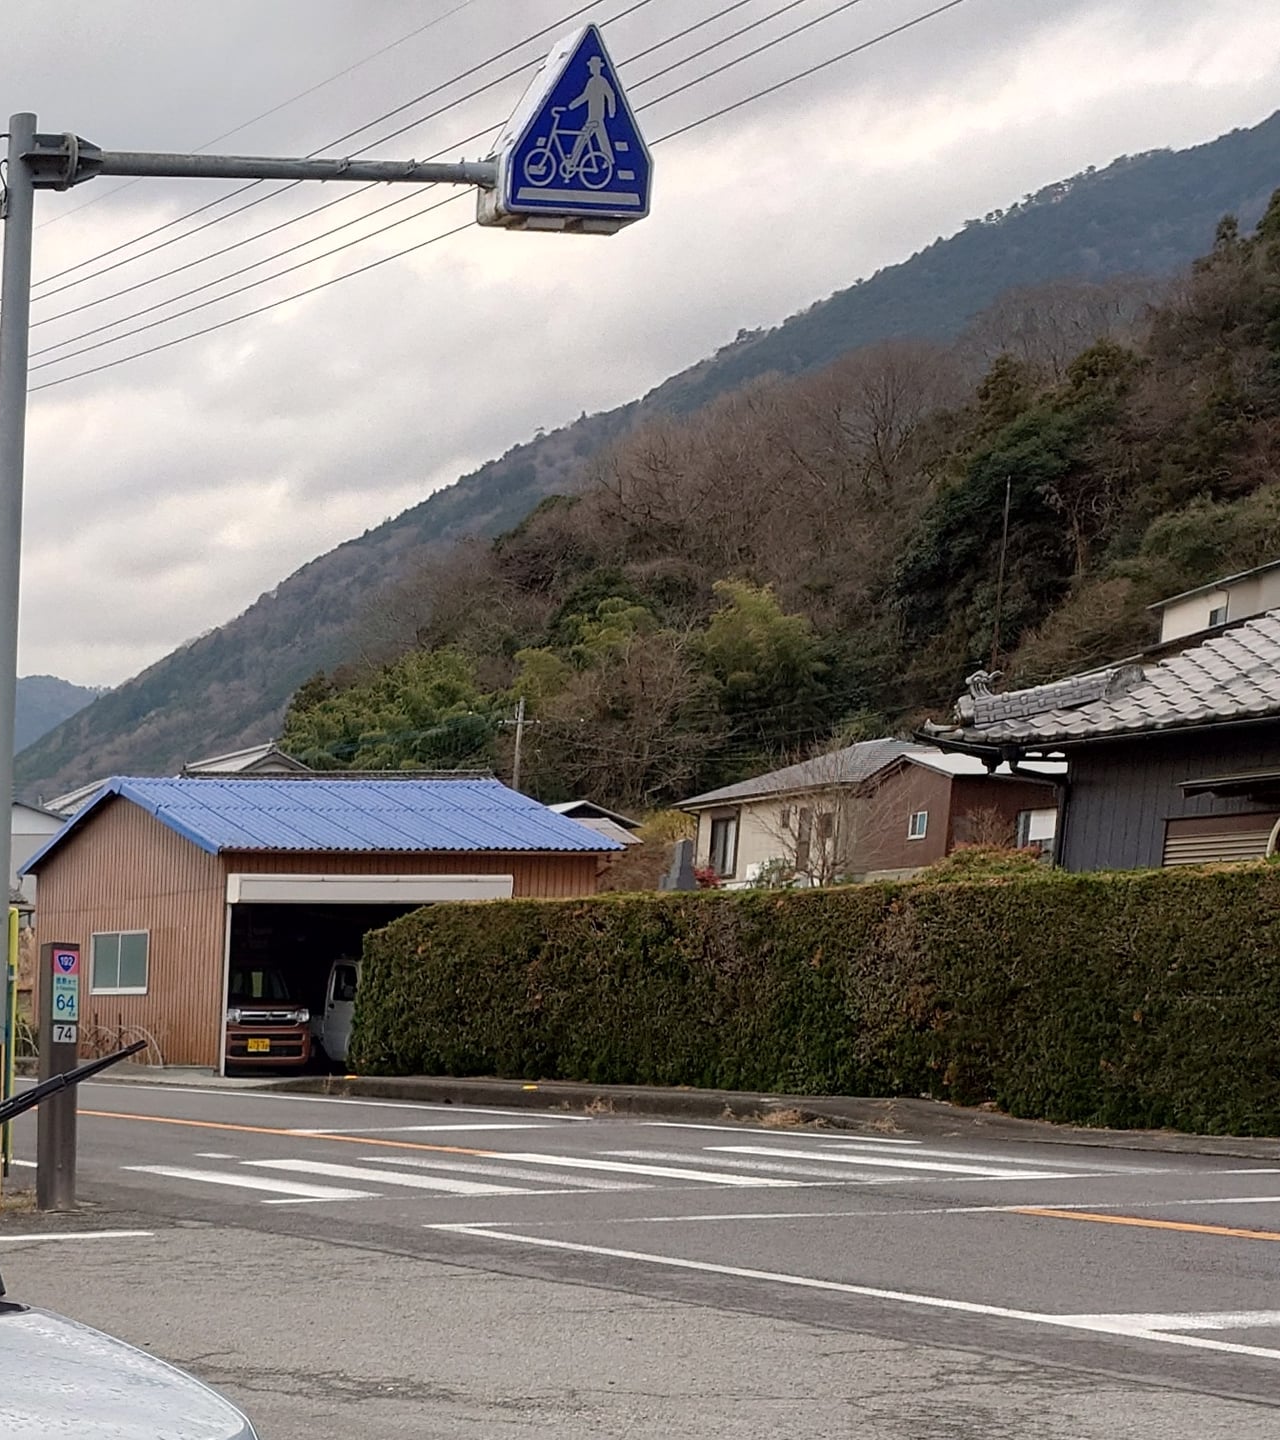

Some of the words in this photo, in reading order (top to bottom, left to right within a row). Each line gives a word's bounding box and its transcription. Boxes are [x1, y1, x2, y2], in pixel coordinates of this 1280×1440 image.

[60, 956, 74, 967] 192
[56, 994, 75, 1012] 64
[56, 1026, 73, 1041] 74
